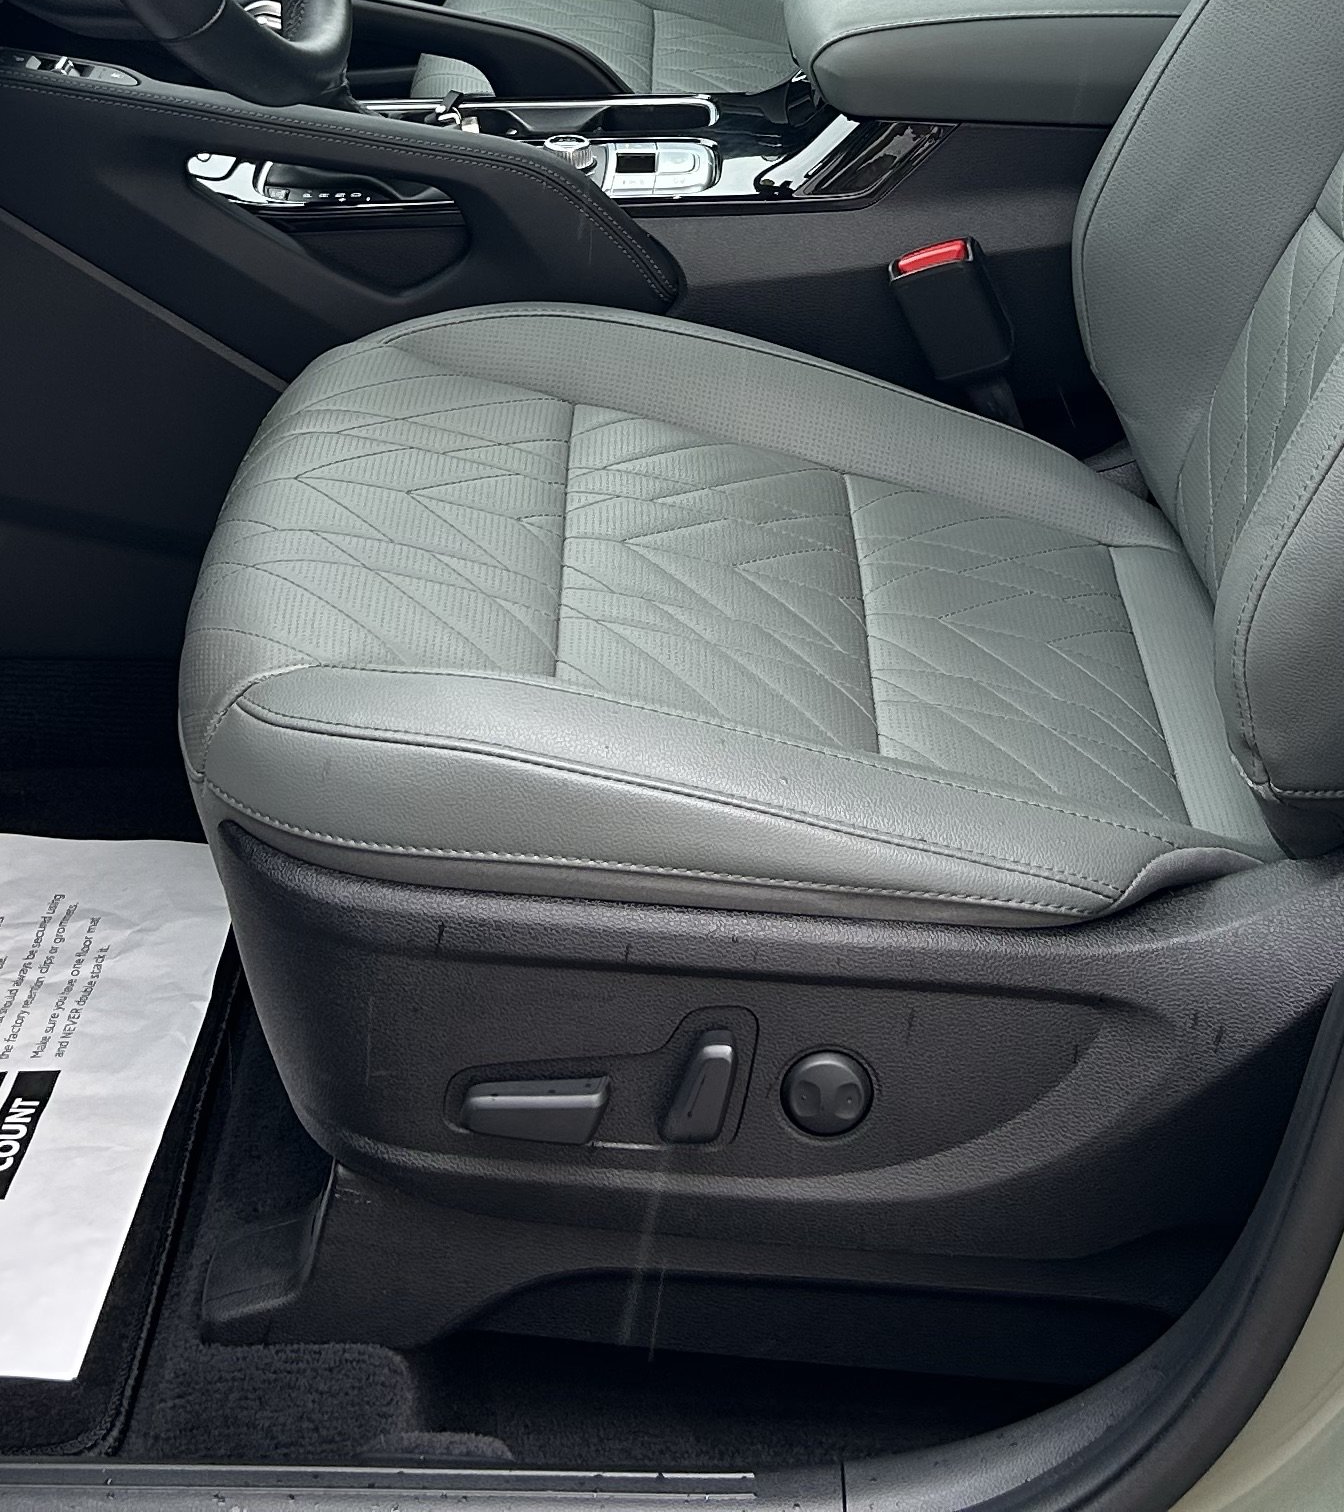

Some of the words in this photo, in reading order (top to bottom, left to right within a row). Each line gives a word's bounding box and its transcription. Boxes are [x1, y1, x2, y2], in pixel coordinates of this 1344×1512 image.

[22, 949, 38, 961] be
[30, 1035, 51, 1058] Make
[45, 1012, 60, 1033] sure
[70, 957, 85, 977] one
[60, 1007, 82, 1039] NEVER
[4, 1009, 30, 1042] factory
[55, 1040, 69, 1058] and
